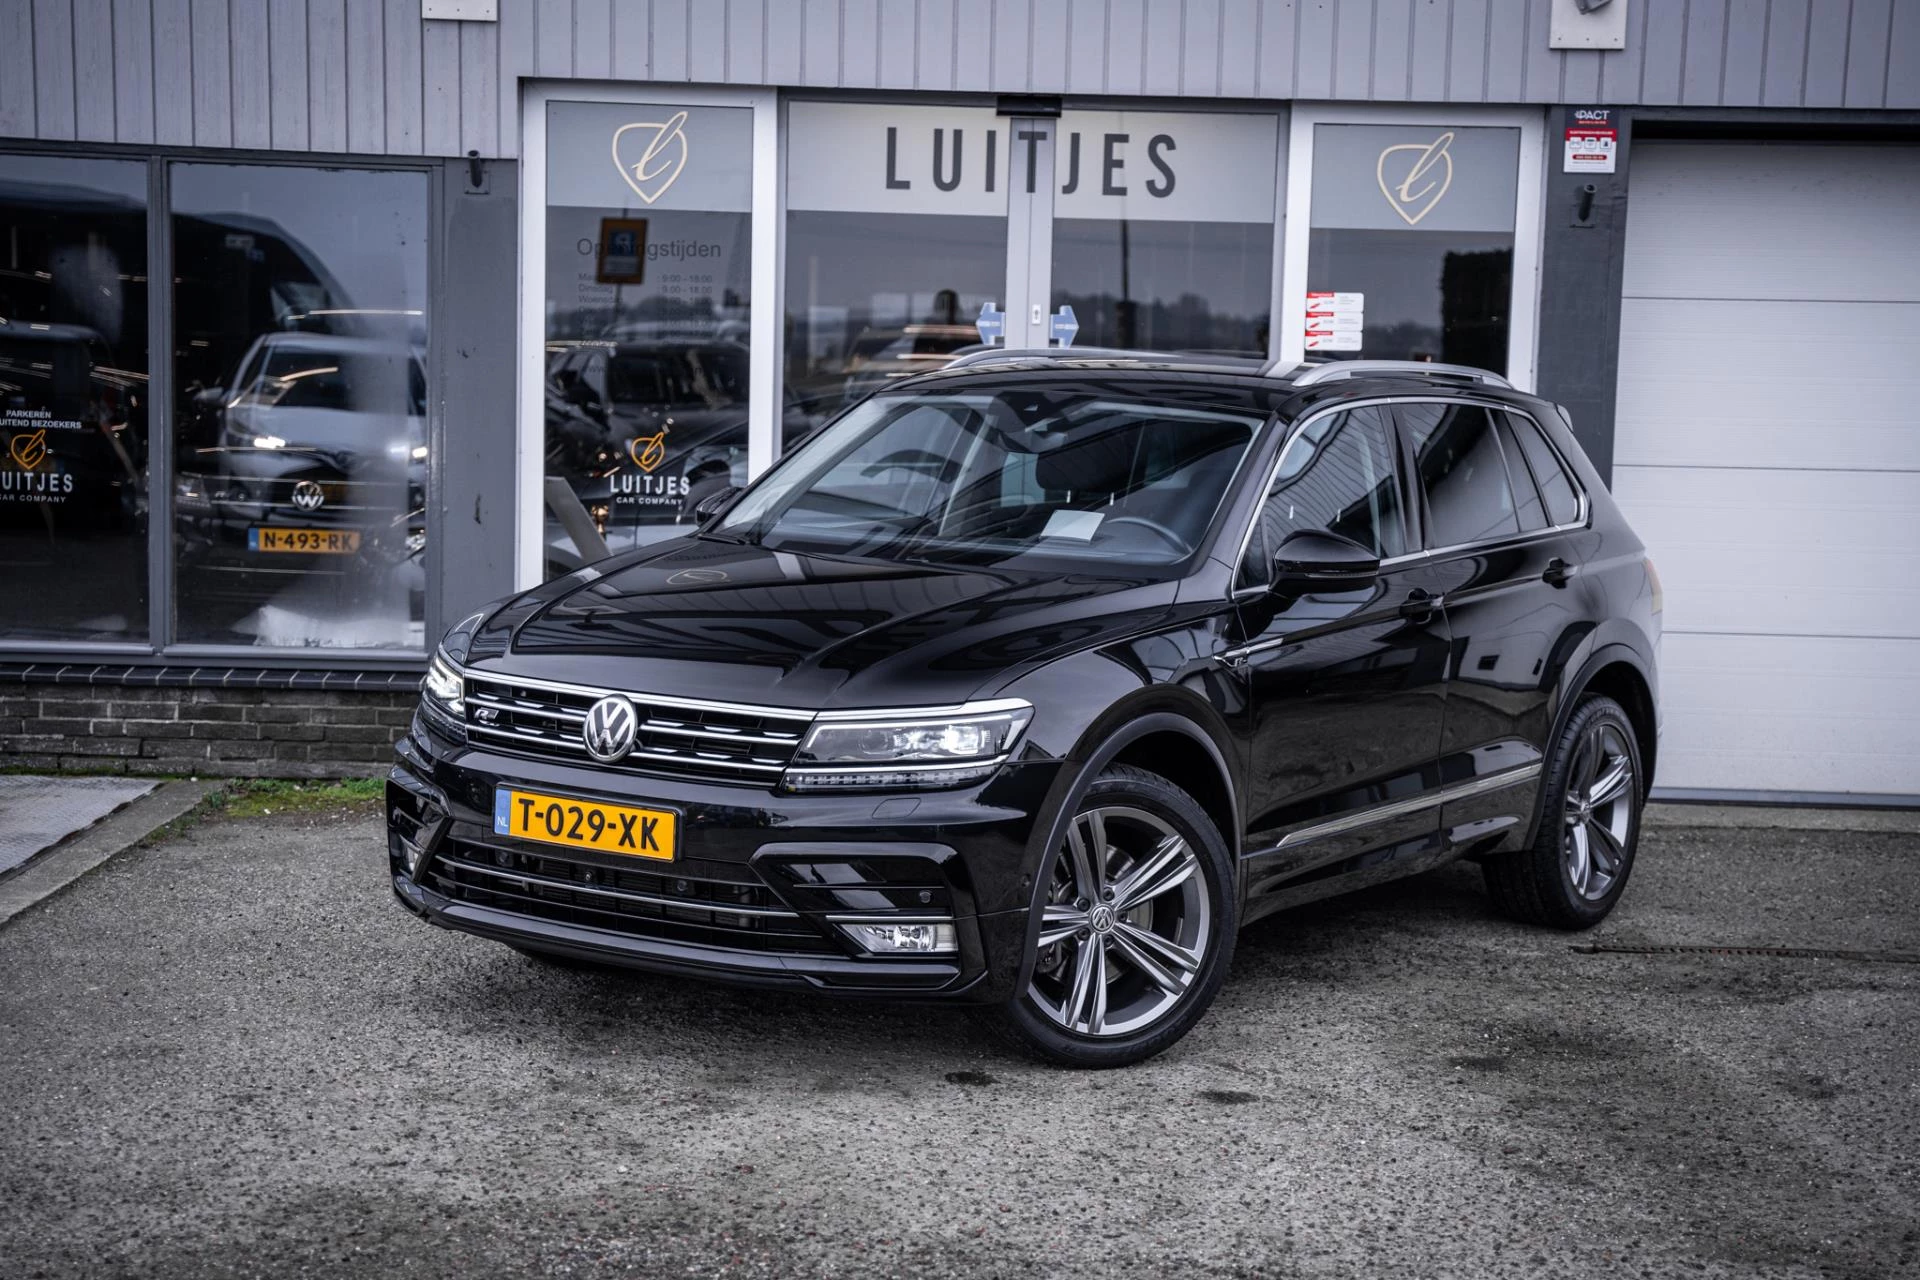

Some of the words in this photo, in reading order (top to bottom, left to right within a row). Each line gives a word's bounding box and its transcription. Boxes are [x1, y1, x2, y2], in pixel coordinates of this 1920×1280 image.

[886, 127, 1177, 198] LUITJES
[6, 410, 51, 419] PARKEREN
[31, 420, 81, 429] BEZOEKERS
[610, 475, 690, 495] LUITJES
[20, 495, 66, 503] COMPANY
[638, 497, 682, 505] COMPANY
[264, 532, 353, 550] N-493-RK
[497, 815, 509, 828] NL
[518, 798, 659, 852] T-029-XK
